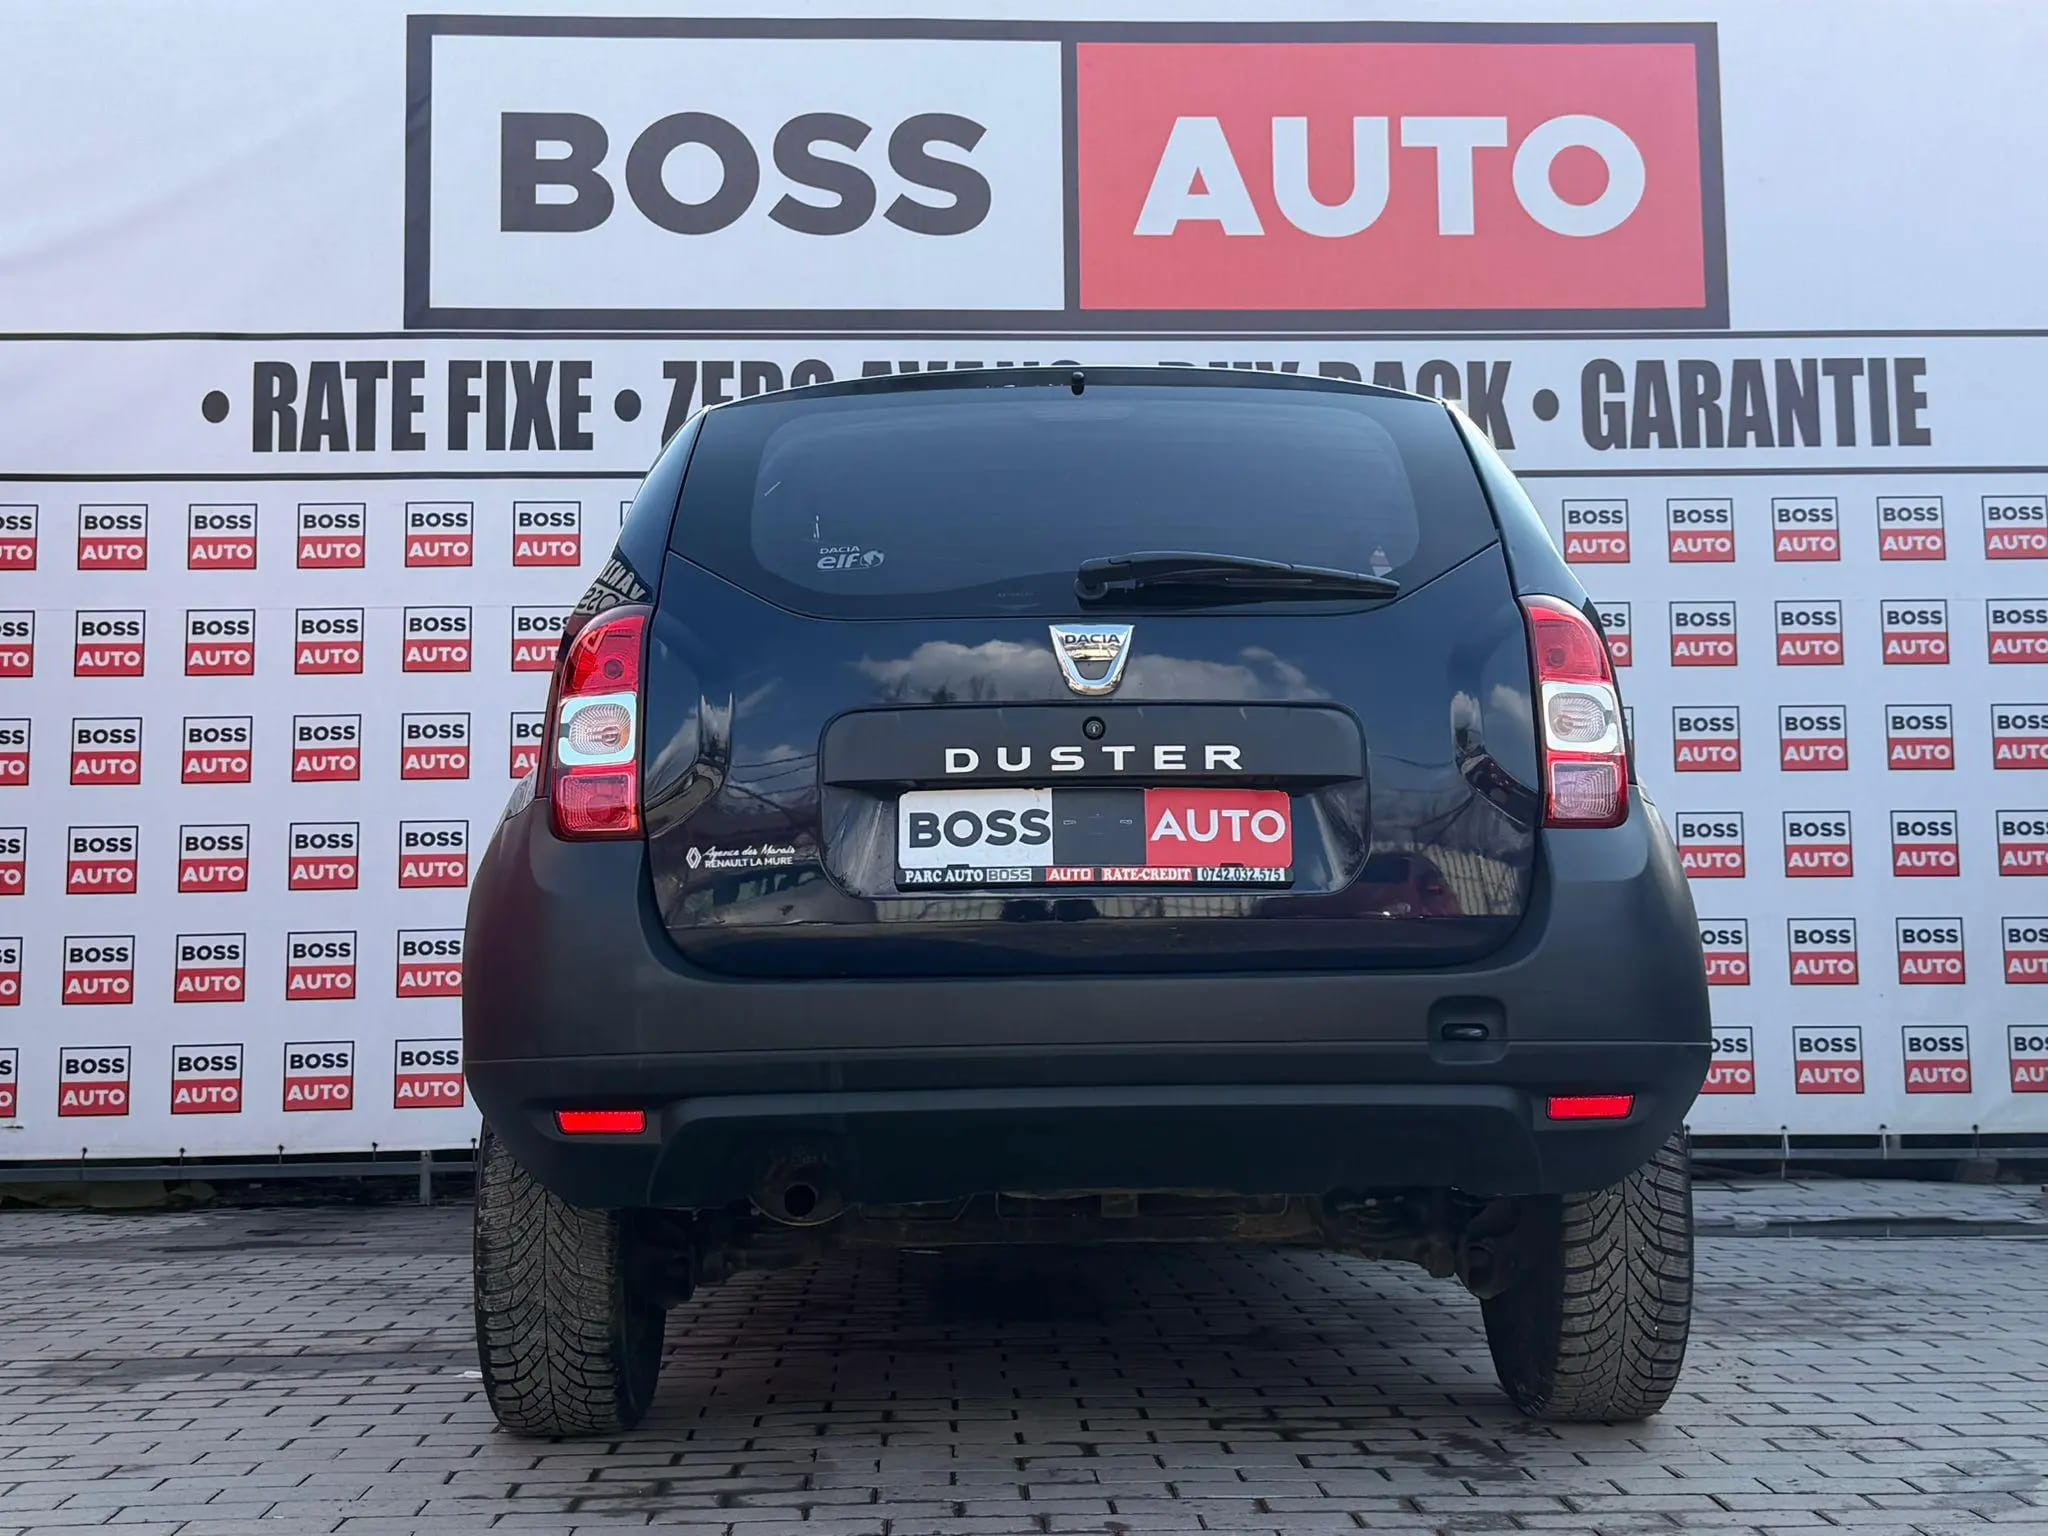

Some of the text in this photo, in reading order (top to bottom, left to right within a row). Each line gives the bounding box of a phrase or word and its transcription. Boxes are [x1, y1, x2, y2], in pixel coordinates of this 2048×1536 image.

[500, 110, 1647, 238] BOSS AUTO
[252, 360, 427, 453] RATE
[447, 360, 595, 452] FIXE
[1580, 357, 1932, 451] GARANTIE
[412, 513, 467, 527] BOSS
[520, 513, 575, 526] BOSS
[1569, 510, 1623, 524] BOSS
[1674, 509, 1727, 523] BOSS
[1778, 509, 1833, 522] BOSS
[1884, 508, 1938, 521] BOSS
[1988, 506, 2043, 520] BOSS
[0, 516, 32, 530] SS
[85, 515, 141, 529] BOSS
[195, 515, 251, 529] BOSS
[304, 514, 360, 528] BOSS
[408, 542, 469, 557] AUTO
[517, 542, 576, 556] AUTO
[819, 545, 861, 555] DACIA
[1567, 539, 1627, 553] AUTO
[1672, 538, 1732, 552] AUTO
[1777, 537, 1837, 552] AUTO
[1882, 536, 1943, 551] AUTO
[1988, 535, 2048, 550] AUTO
[3, 546, 32, 560] TO
[82, 545, 143, 559] AUTO
[192, 544, 252, 559] AUTO
[301, 544, 361, 558] AUTO
[410, 617, 466, 632] BOSS
[1601, 613, 1625, 627] SS
[1676, 612, 1730, 626] BOSS
[1782, 611, 1836, 625] BOSS
[1888, 611, 1942, 624] BOSS
[1992, 610, 2048, 624] BOSS
[2, 622, 28, 637] SS
[82, 621, 139, 636] BOSS
[192, 621, 249, 635] BOSS
[302, 619, 358, 634] BOSS
[1064, 634, 1121, 644] DACIA
[1992, 639, 2048, 654] AUTO
[407, 647, 467, 661] AUTO
[515, 646, 559, 661] AUT
[1674, 642, 1734, 656] AUTO
[1780, 640, 1840, 655] AUTO
[1886, 640, 1946, 654] AUTO
[0, 652, 29, 666] TO
[79, 652, 140, 666] AUTO
[189, 650, 250, 665] AUTO
[299, 649, 359, 664] AUTO
[1679, 717, 1734, 731] BOSS
[1786, 716, 1841, 730] BOSS
[1892, 716, 1947, 729] BOSS
[0, 730, 24, 744] SS
[78, 729, 136, 744] BOSS
[189, 728, 246, 743] BOSS
[299, 726, 355, 741] BOSS
[408, 724, 464, 739] BOSS
[517, 724, 543, 738] BO
[944, 745, 1243, 774] DUSTER
[1677, 747, 1738, 761] AUTO
[1783, 746, 1845, 760] AUTO
[1891, 745, 1951, 759] AUTO
[75, 760, 136, 774] AUTO
[186, 758, 247, 772] AUTO
[296, 756, 355, 771] AUTO
[405, 754, 465, 769] AUTO
[909, 807, 1286, 849] BOSS AUTO
[1683, 823, 1738, 837] BOSS
[1790, 822, 1845, 837] BOSS
[1897, 822, 1952, 836] BOSS
[2003, 821, 2048, 836] BOS
[74, 837, 132, 853] BOSS
[186, 836, 243, 851] BOSS
[296, 834, 353, 849] BOSS
[406, 832, 463, 847] BOSS
[704, 856, 793, 868] RENAULT LA MURE
[1680, 853, 1741, 868] AUTO
[1788, 852, 1850, 867] AUTO
[1896, 852, 1956, 866] AUTO
[2003, 851, 2048, 866] AUT
[71, 868, 132, 883] AUTO
[183, 866, 244, 881] AUTO
[293, 864, 354, 879] AUTO
[403, 862, 463, 877] AUTO
[905, 869, 942, 883] PARC
[944, 869, 984, 883] AUTO
[987, 868, 1031, 882] BOSS
[1048, 867, 1092, 881] AUTO
[1102, 867, 1192, 881] RATE-CREDIT
[1702, 930, 1742, 944] OSS
[1794, 929, 1851, 944] BOSS
[1903, 929, 1958, 943] BOSS
[2008, 928, 2048, 943] BOS
[70, 947, 128, 963] BOSS
[182, 945, 239, 961] BOSS
[293, 943, 350, 958] BOSS
[403, 940, 460, 956] BOSS
[1705, 960, 1745, 975] UTO
[1793, 960, 1855, 974] AUTO
[1902, 959, 1962, 973] AUTO
[2009, 959, 2048, 973] AUT
[66, 978, 129, 993] AUTO
[179, 976, 240, 991] AUTO
[290, 973, 351, 989] AUTO
[401, 971, 461, 986] AUTO
[1800, 1038, 1856, 1052] BOSS
[1909, 1037, 1964, 1052] BOSS
[2014, 1037, 2048, 1052] BO
[178, 1056, 237, 1072] BOSS
[290, 1053, 348, 1069] BOSS
[401, 1050, 459, 1066] BOSS
[66, 1058, 124, 1074] BOSS
[1705, 1069, 1750, 1084] UTO
[1799, 1069, 1860, 1083] AUTO
[1908, 1068, 1967, 1082] AUTO
[2015, 1068, 2048, 1082] AU
[175, 1087, 237, 1103] AUTO
[288, 1085, 348, 1100] AUTO
[399, 1081, 459, 1097] AUTO
[63, 1090, 124, 1105] AUTO
